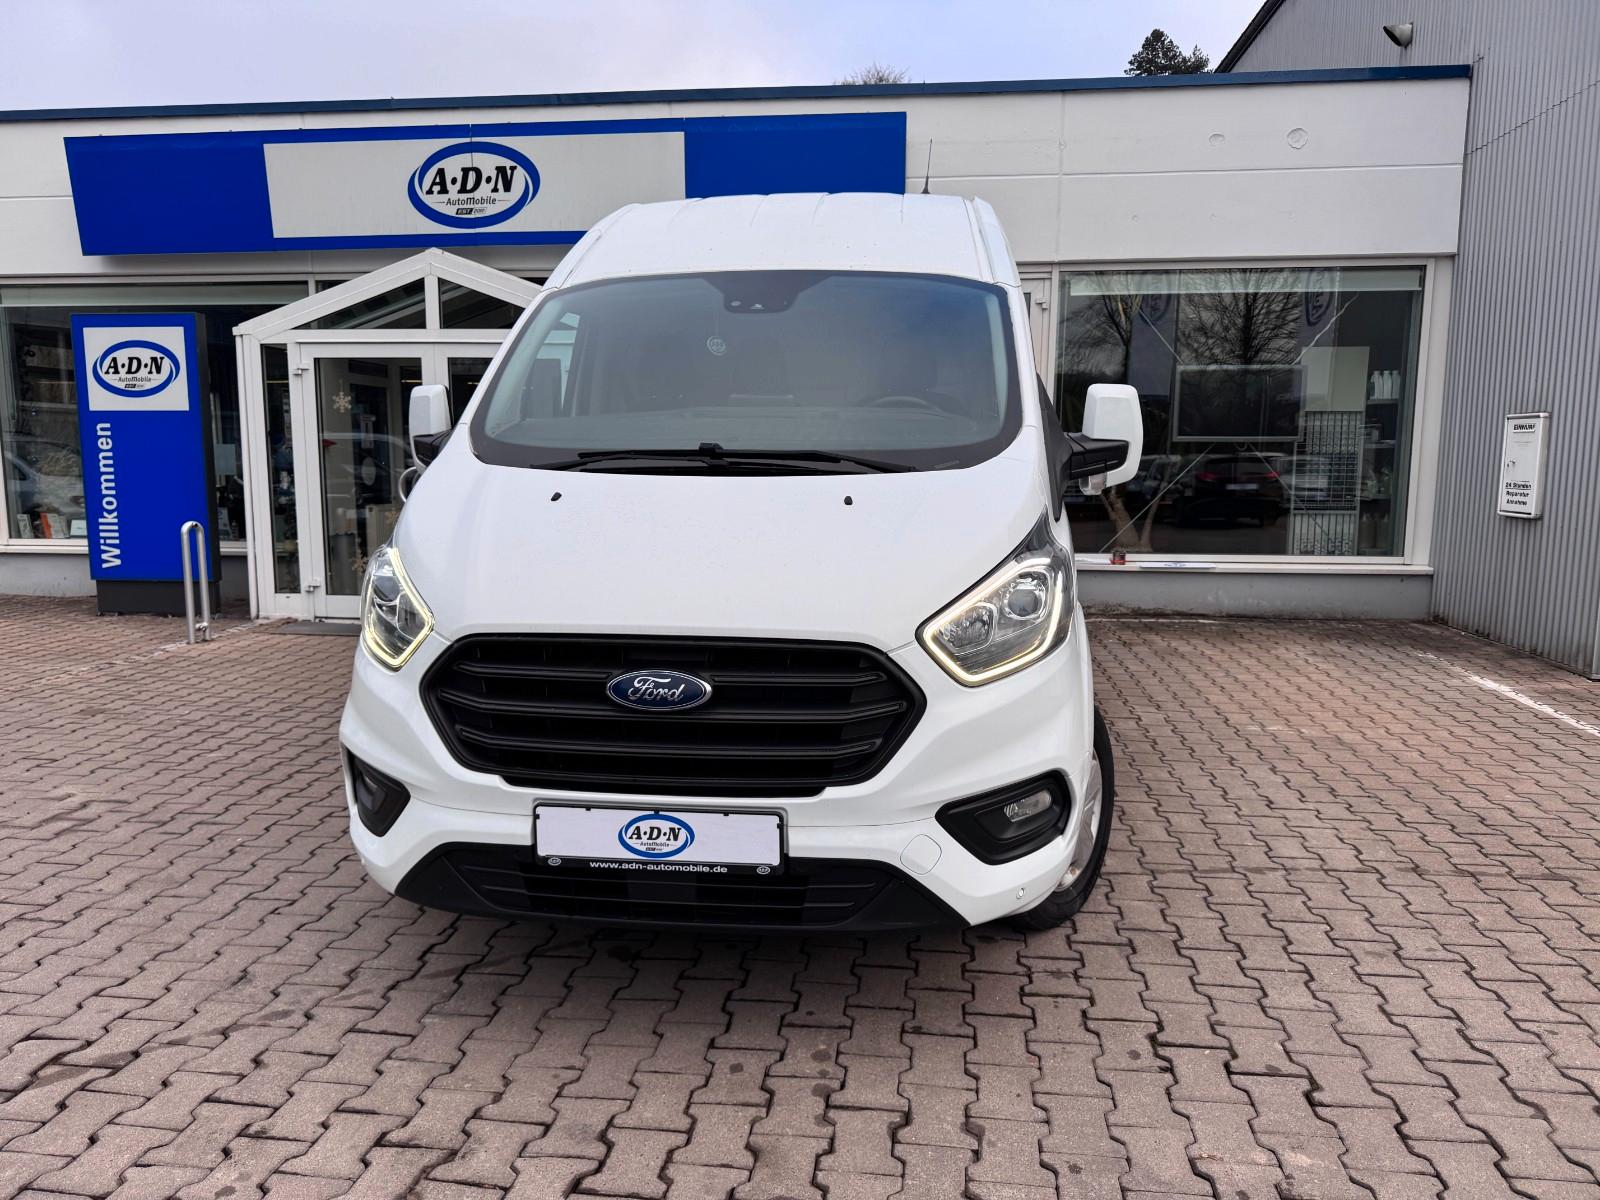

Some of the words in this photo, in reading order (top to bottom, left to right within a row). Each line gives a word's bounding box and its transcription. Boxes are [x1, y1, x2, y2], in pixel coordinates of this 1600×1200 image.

[445, 195, 497, 206] AutoMobile
[96, 422, 122, 568] Willkommen
[628, 676, 686, 701] Ford
[588, 860, 728, 874] www.adn-automobile.de
